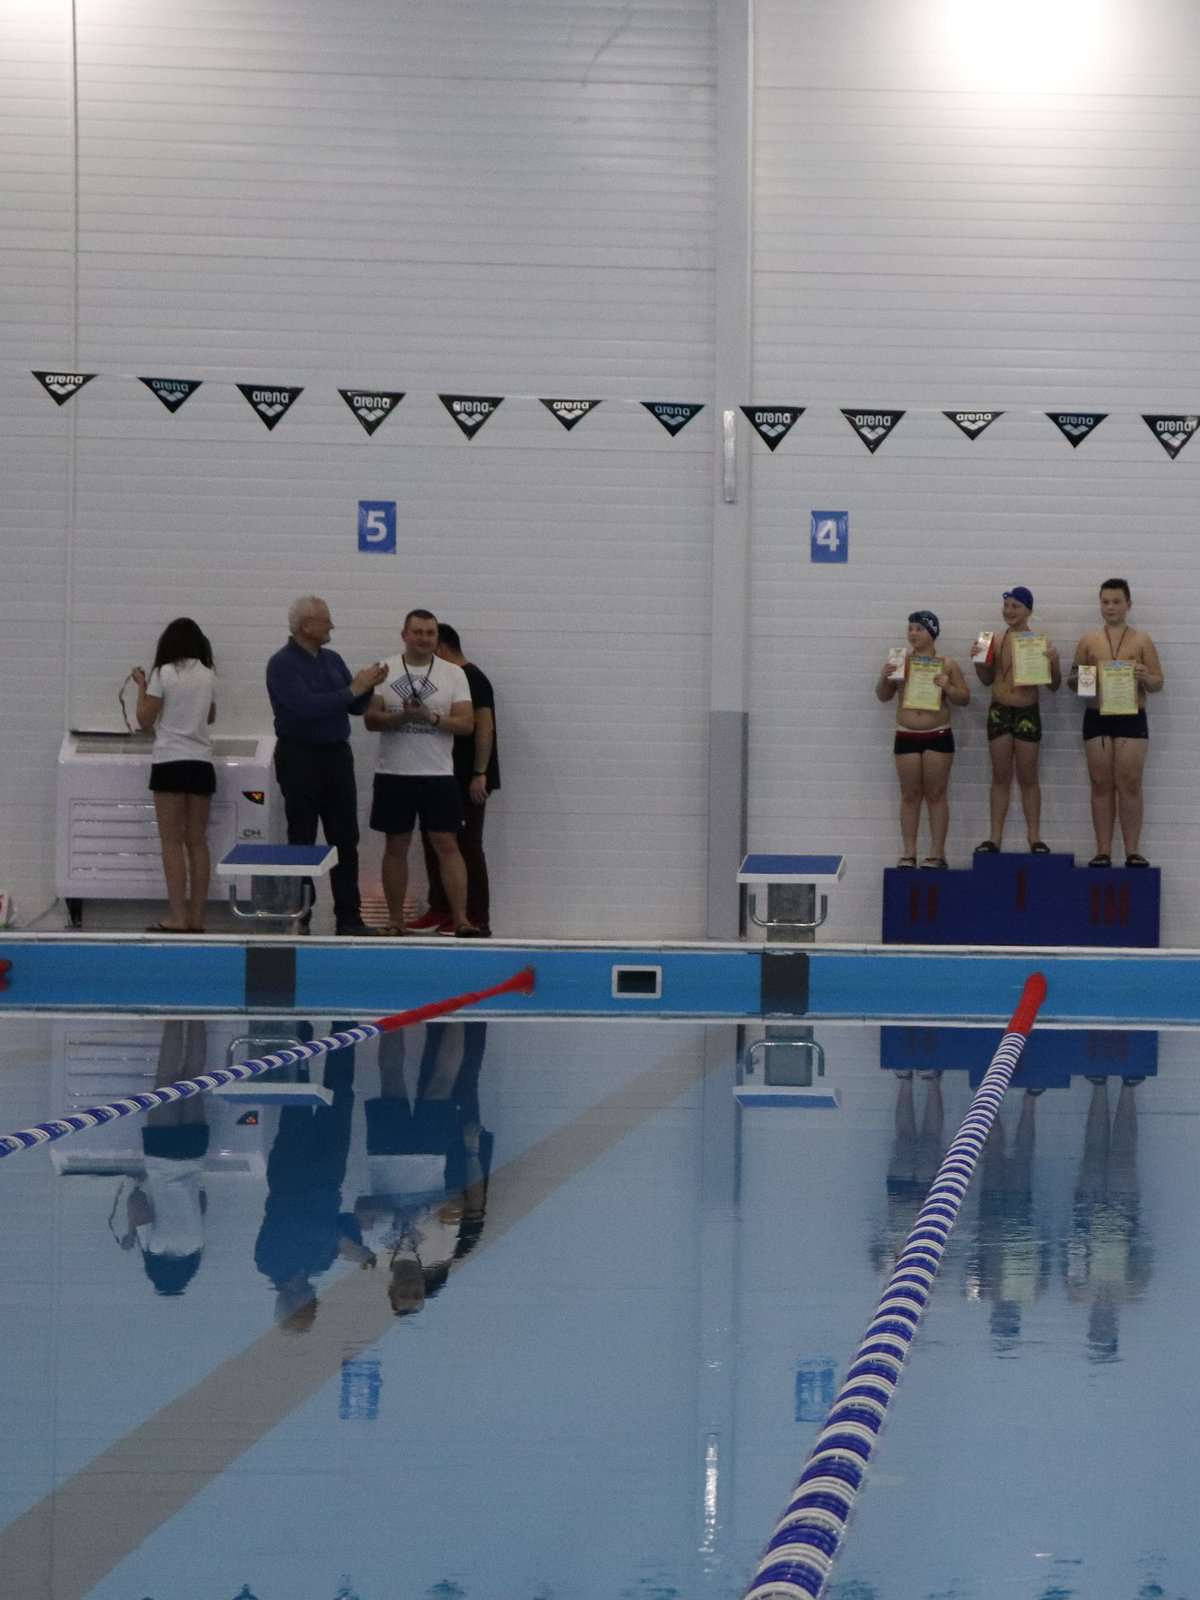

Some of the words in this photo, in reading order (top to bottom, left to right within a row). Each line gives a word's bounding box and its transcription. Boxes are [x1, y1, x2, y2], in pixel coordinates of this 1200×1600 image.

[45, 374, 83, 384] arena
[152, 380, 189, 391] arena
[253, 390, 289, 403] arena
[354, 395, 390, 408] arena
[453, 401, 489, 412] arena
[553, 401, 589, 410] arena
[655, 405, 690, 415] arena
[756, 411, 791, 423] arena
[856, 415, 891, 426] arena
[956, 413, 992, 421] arena
[1059, 414, 1094, 425] arena
[1157, 419, 1193, 431] arena
[366, 510, 388, 543] 5
[816, 520, 840, 551] 4
[1090, 883, 1130, 927] III
